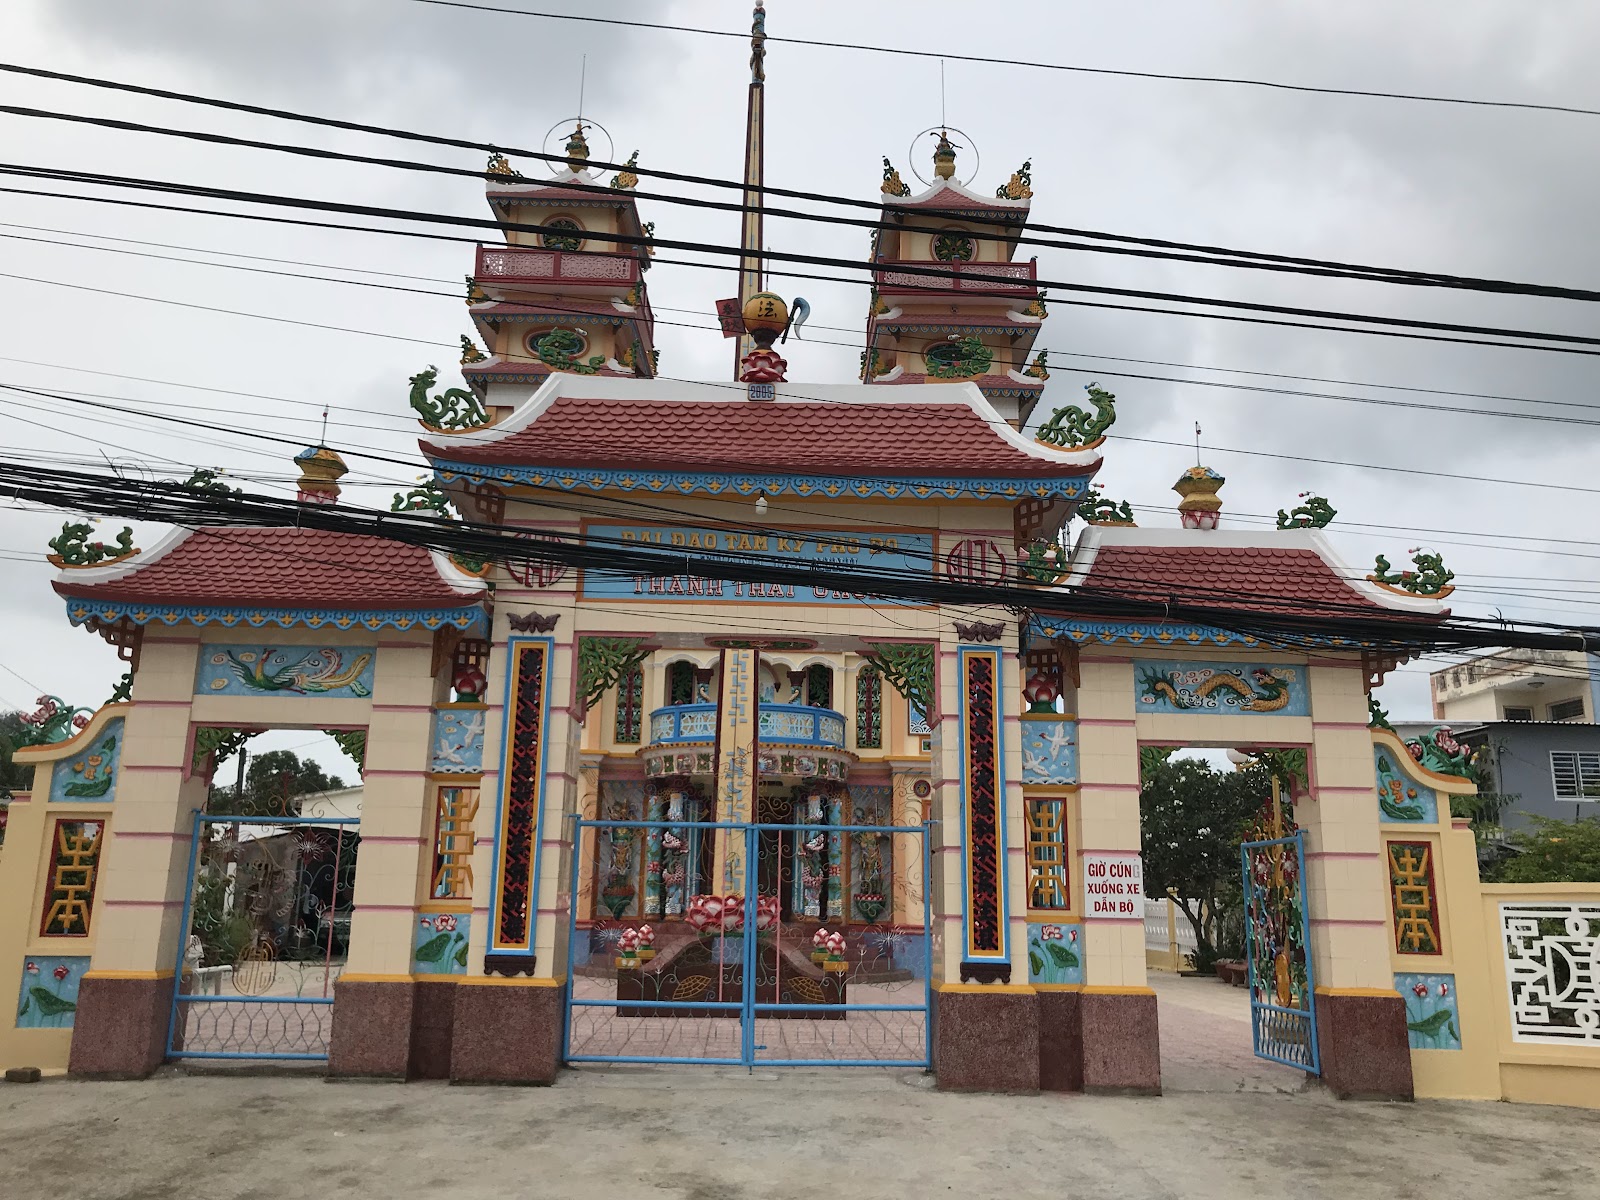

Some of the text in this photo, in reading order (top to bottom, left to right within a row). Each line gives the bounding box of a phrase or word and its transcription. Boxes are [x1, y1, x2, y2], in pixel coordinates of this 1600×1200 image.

[750, 385, 772, 399] 2005
[1088, 860, 1140, 878] GIỜ CÚNG
[1087, 879, 1140, 895] XUỐNG XE
[1094, 896, 1134, 916] DẪN BỘ
